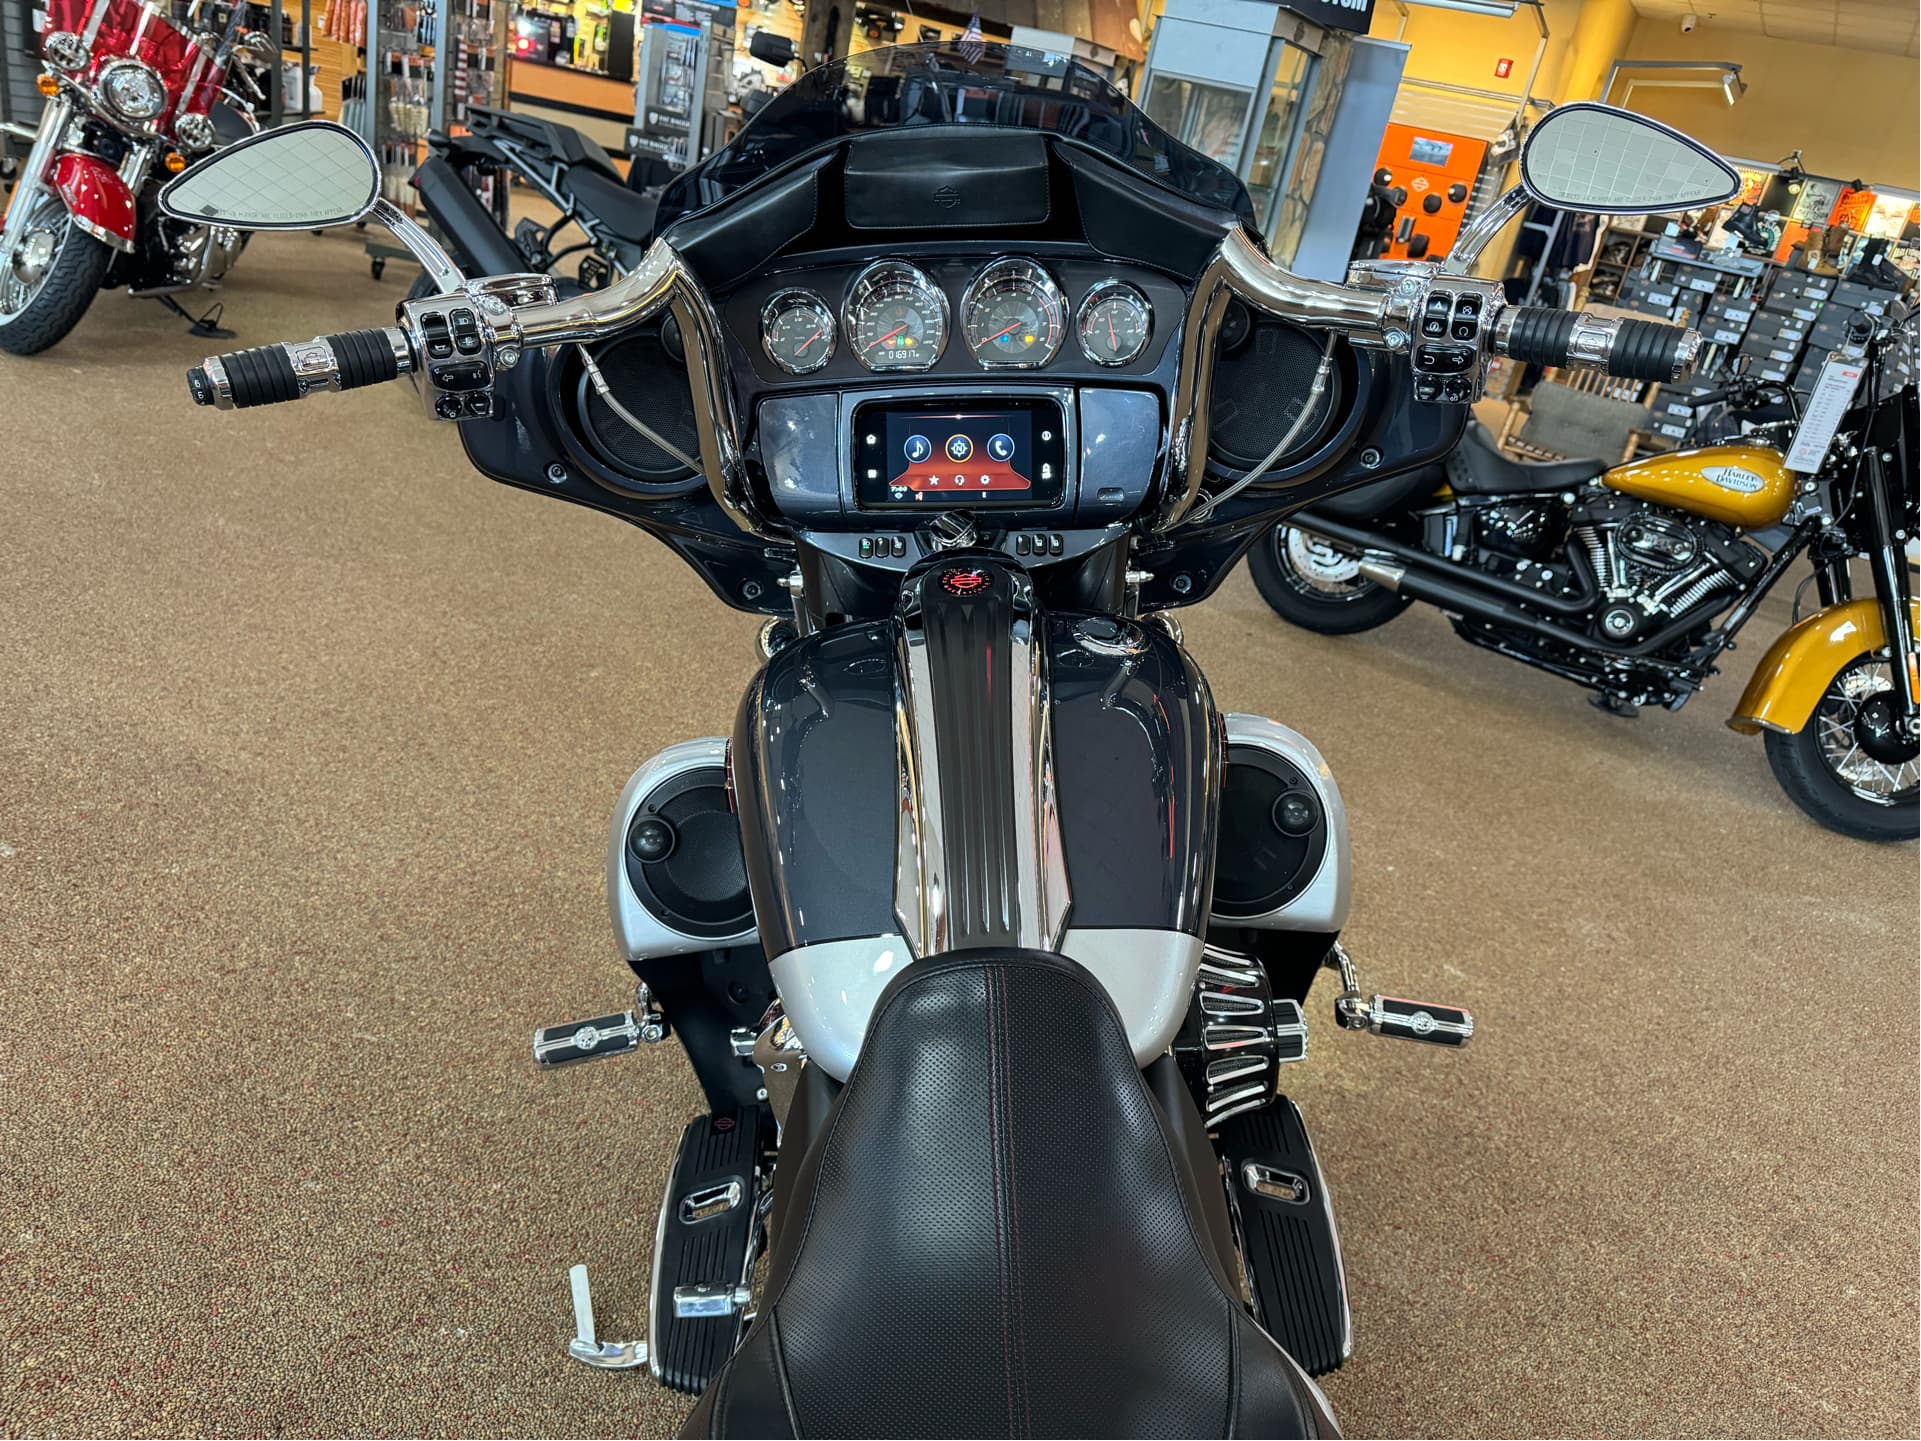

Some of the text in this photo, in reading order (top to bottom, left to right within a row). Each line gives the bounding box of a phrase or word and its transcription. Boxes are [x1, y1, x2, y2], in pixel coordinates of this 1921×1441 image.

[194, 379, 201, 388] 6
[1715, 473, 1758, 490] DAVIDSON
[1723, 467, 1758, 482] HARLEY
